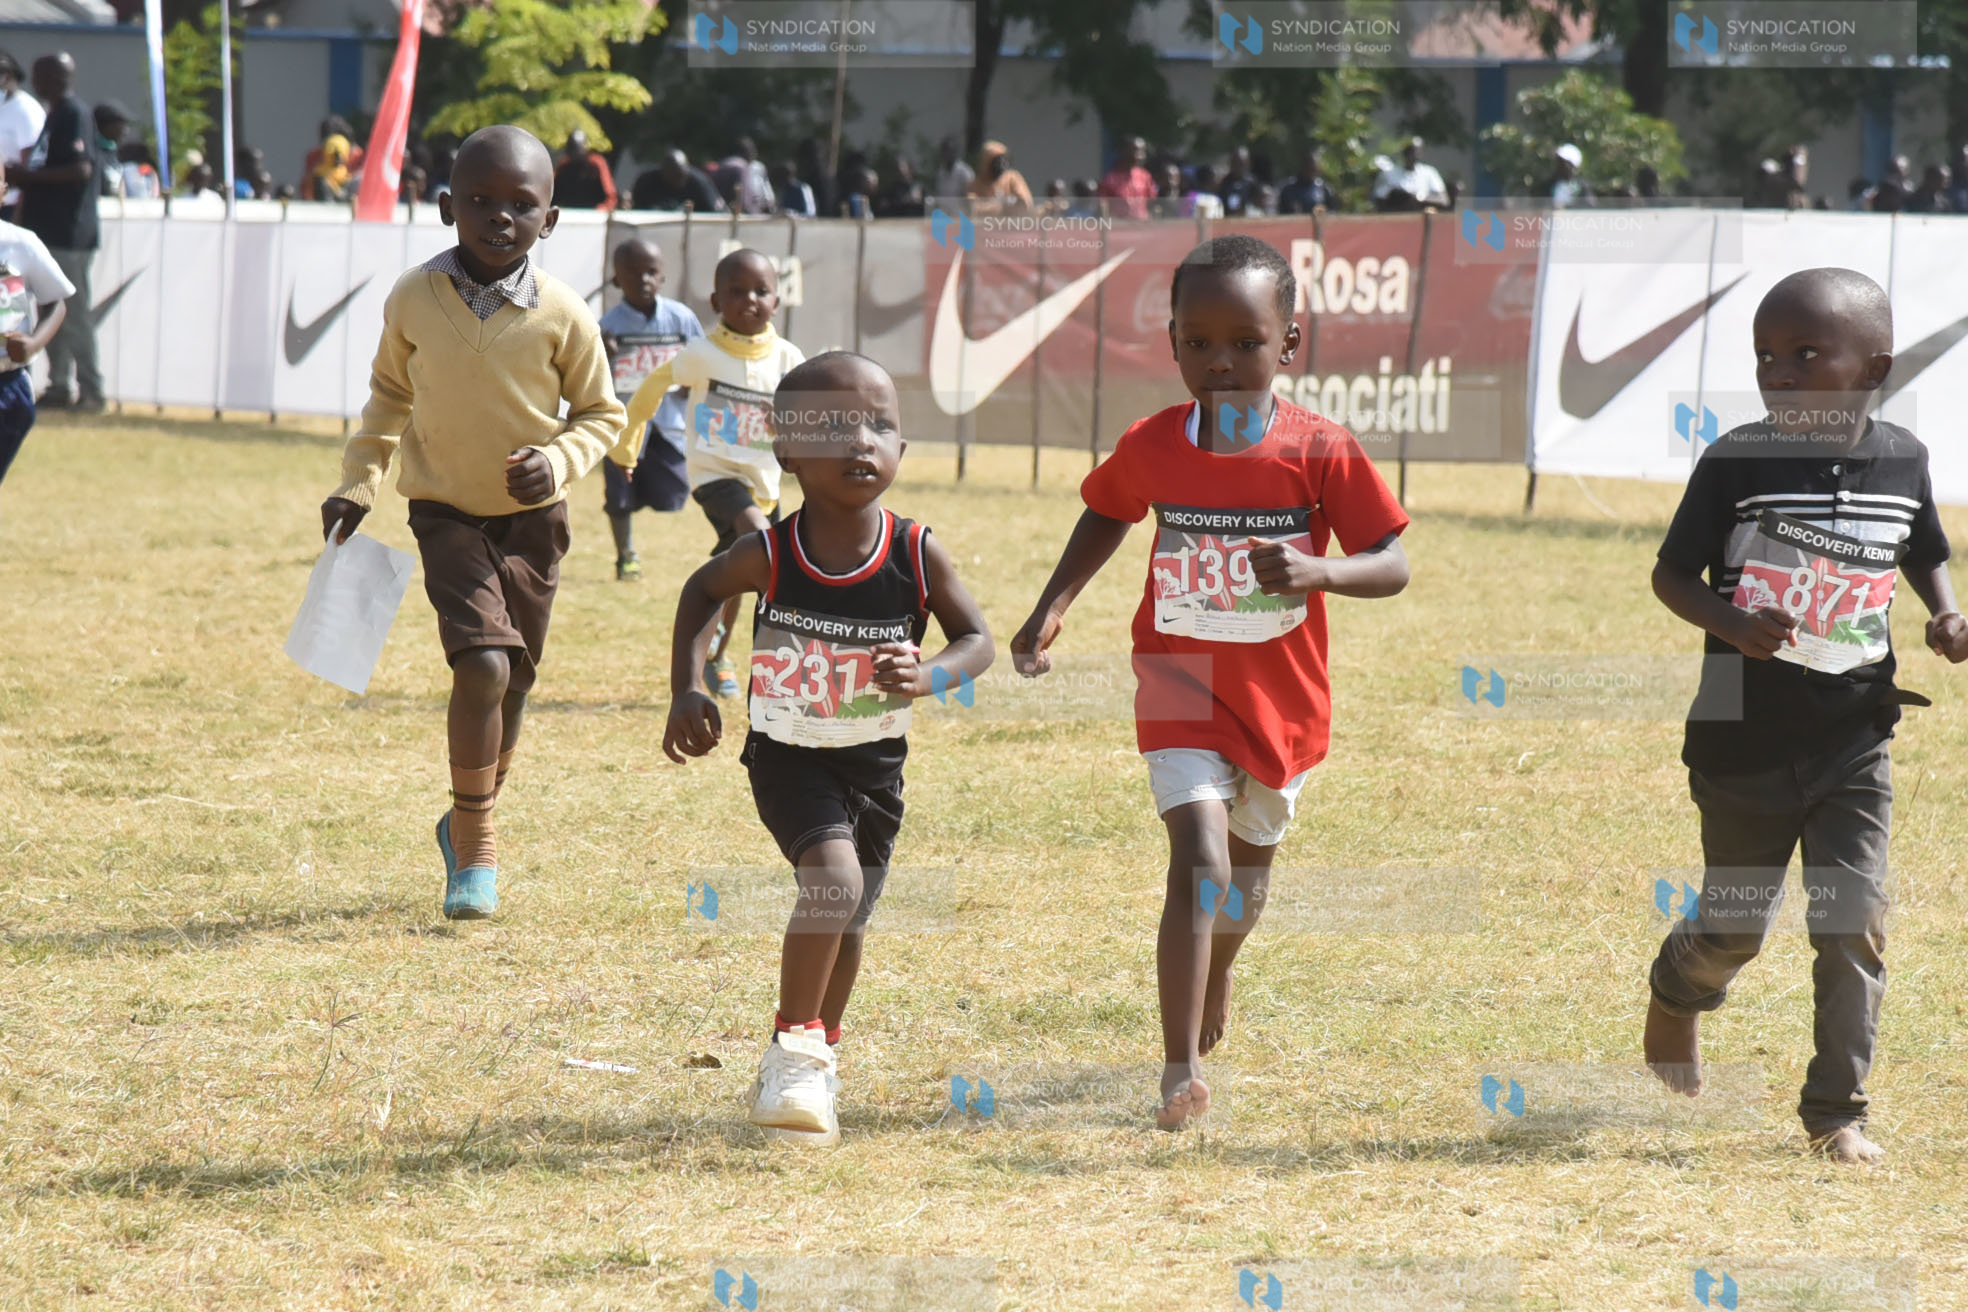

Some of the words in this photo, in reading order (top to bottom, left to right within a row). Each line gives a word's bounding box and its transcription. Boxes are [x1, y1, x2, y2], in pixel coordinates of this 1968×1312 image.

[1291, 238, 1410, 315] Rosa
[1270, 355, 1452, 433] ssociati
[1164, 511, 1242, 528] DISCOVERY
[1246, 514, 1295, 528] KENYA
[1777, 521, 1863, 558] DISCOVERY
[1862, 546, 1895, 562] KENYA
[1171, 546, 1262, 597] 139
[1782, 566, 1872, 629] 871
[769, 608, 854, 638] DISCOVERY
[857, 625, 905, 639] KENYA
